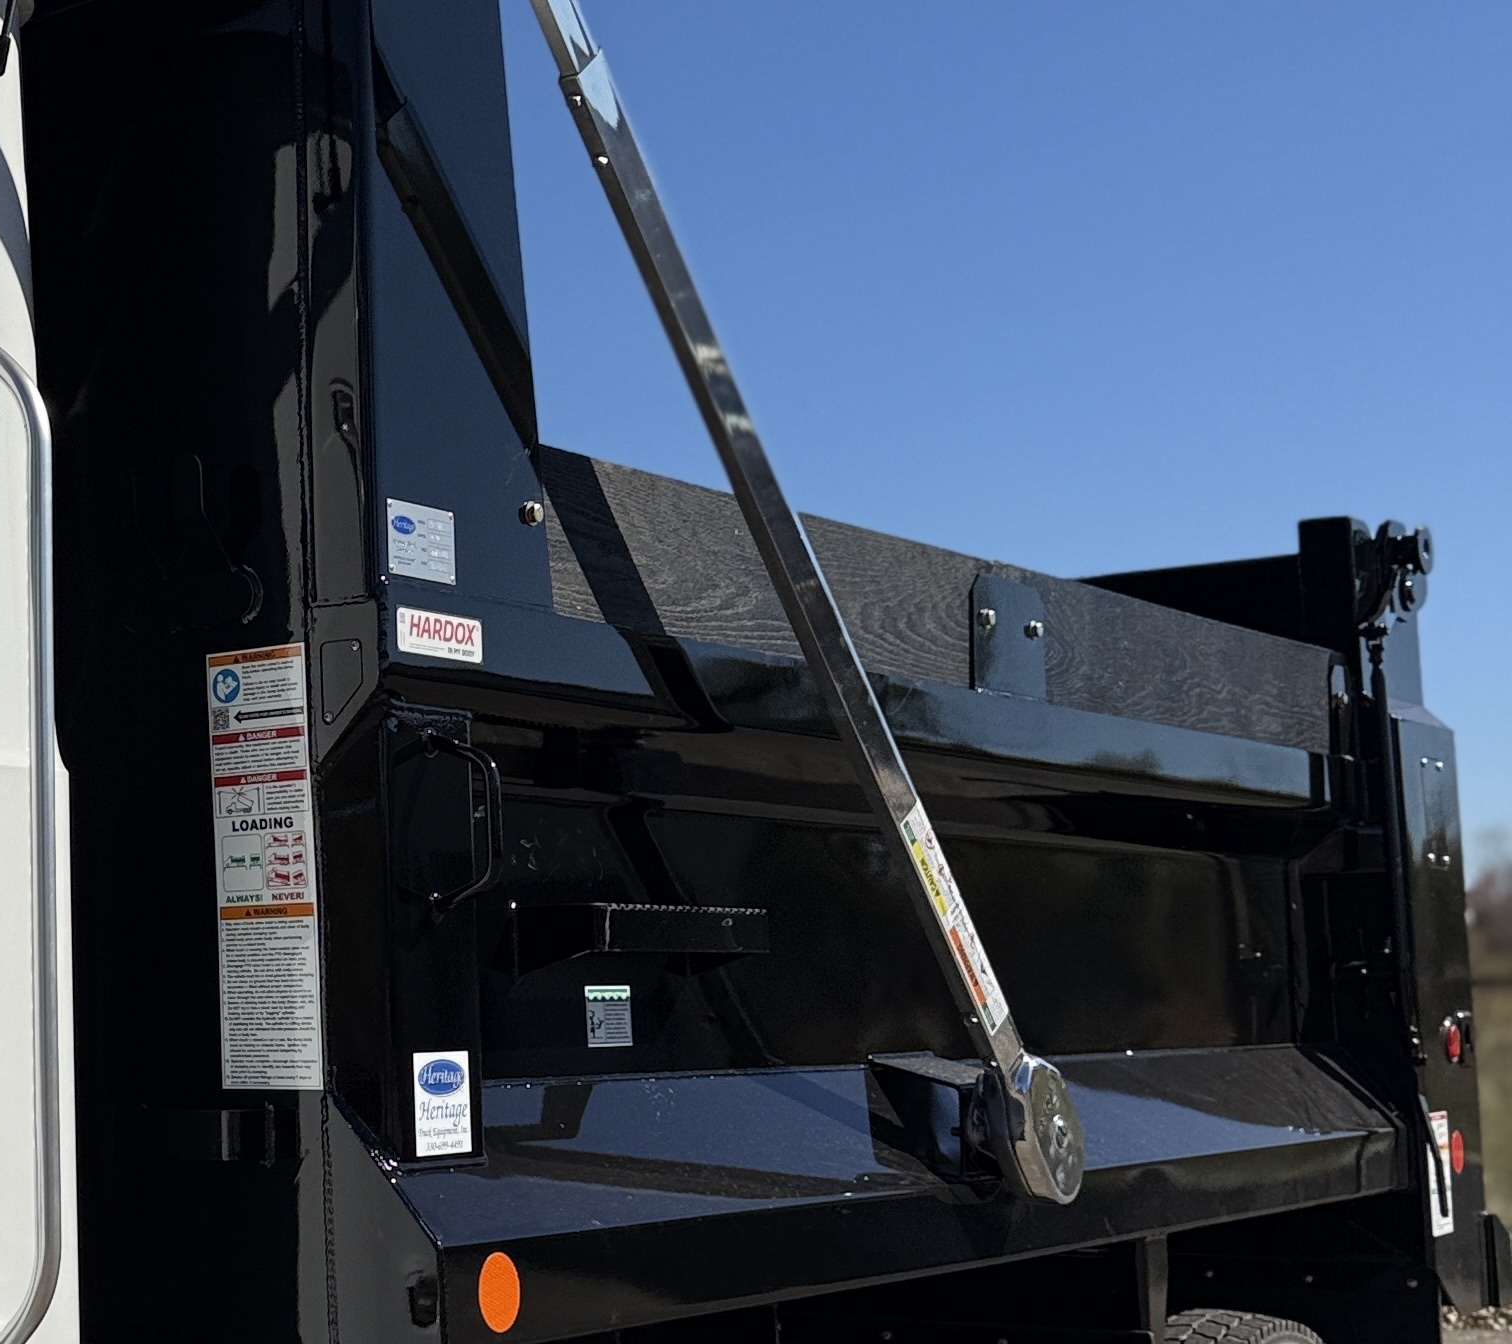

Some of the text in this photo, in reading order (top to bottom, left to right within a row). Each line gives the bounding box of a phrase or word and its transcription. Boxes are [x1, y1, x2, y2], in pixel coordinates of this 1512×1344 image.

[246, 730, 277, 741] DANGER
[247, 773, 278, 784] DANGER
[232, 816, 294, 832] LOADING
[271, 892, 304, 901] NEVER!
[253, 906, 288, 916] WARNING
[420, 1063, 464, 1089] Heritage
[418, 1098, 468, 1127] Heritage
